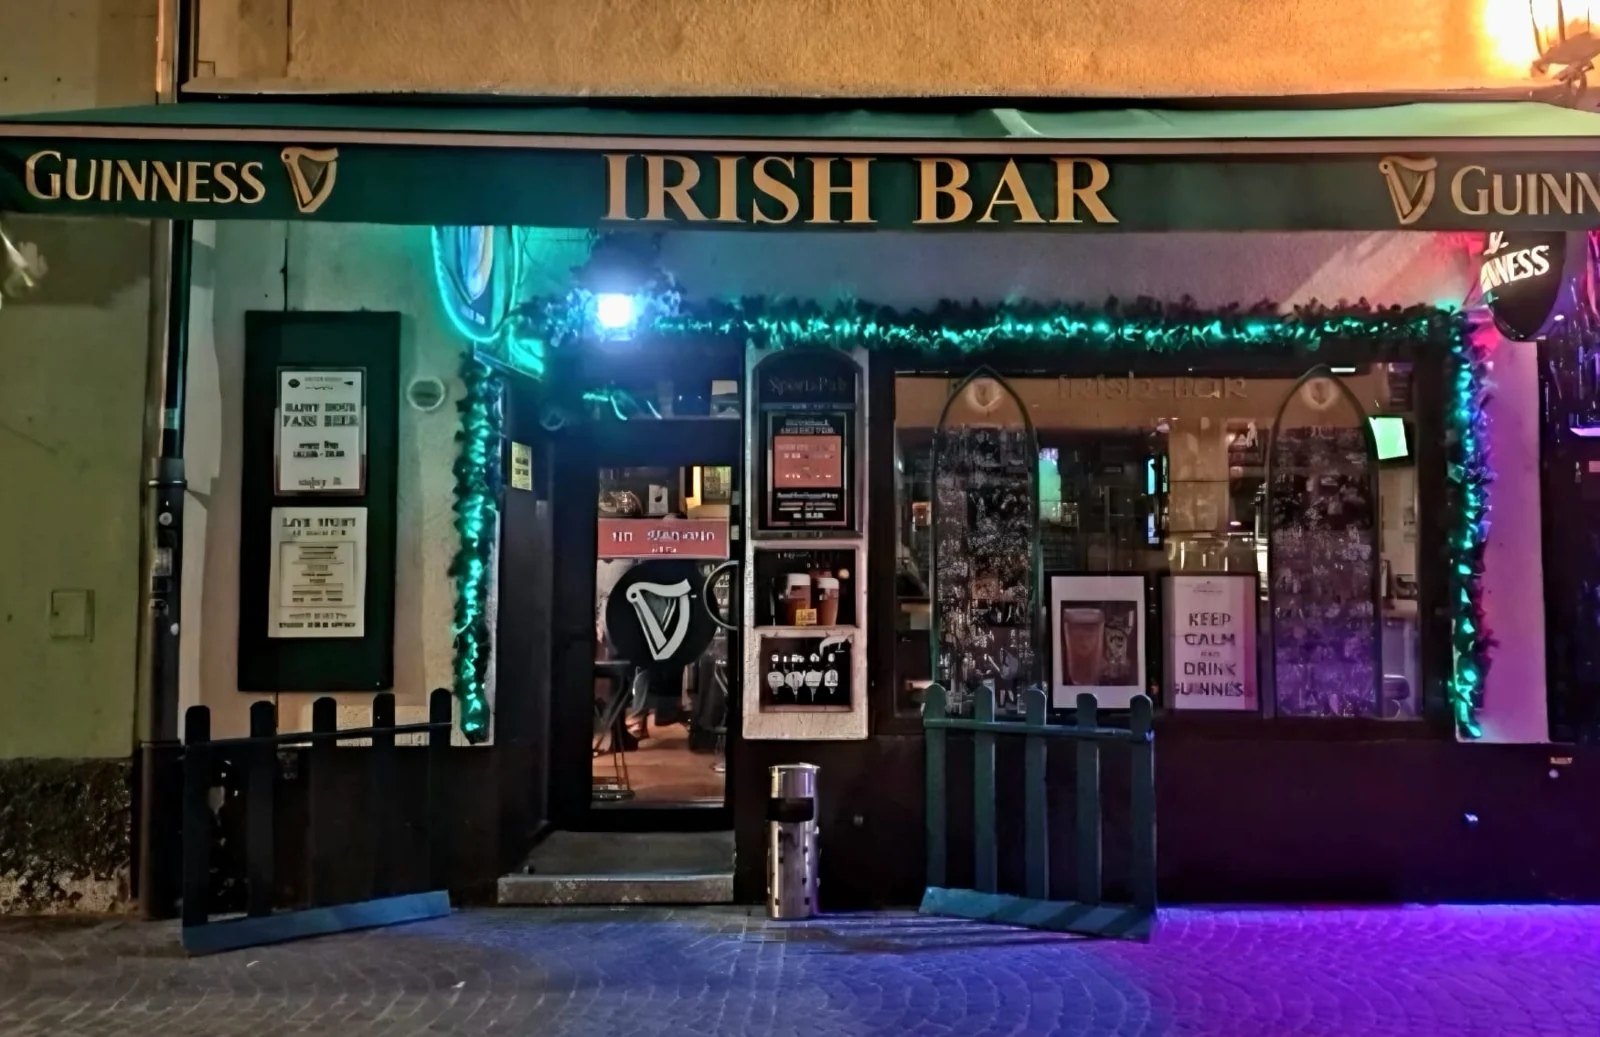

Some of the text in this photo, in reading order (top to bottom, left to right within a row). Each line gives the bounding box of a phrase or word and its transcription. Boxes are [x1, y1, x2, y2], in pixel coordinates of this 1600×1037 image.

[25, 151, 266, 204] GUINNESS
[600, 154, 1119, 224] IRISH BAR
[1188, 612, 1231, 627] KEEP
[1184, 633, 1236, 647] CALM
[1184, 661, 1237, 676] DRINK
